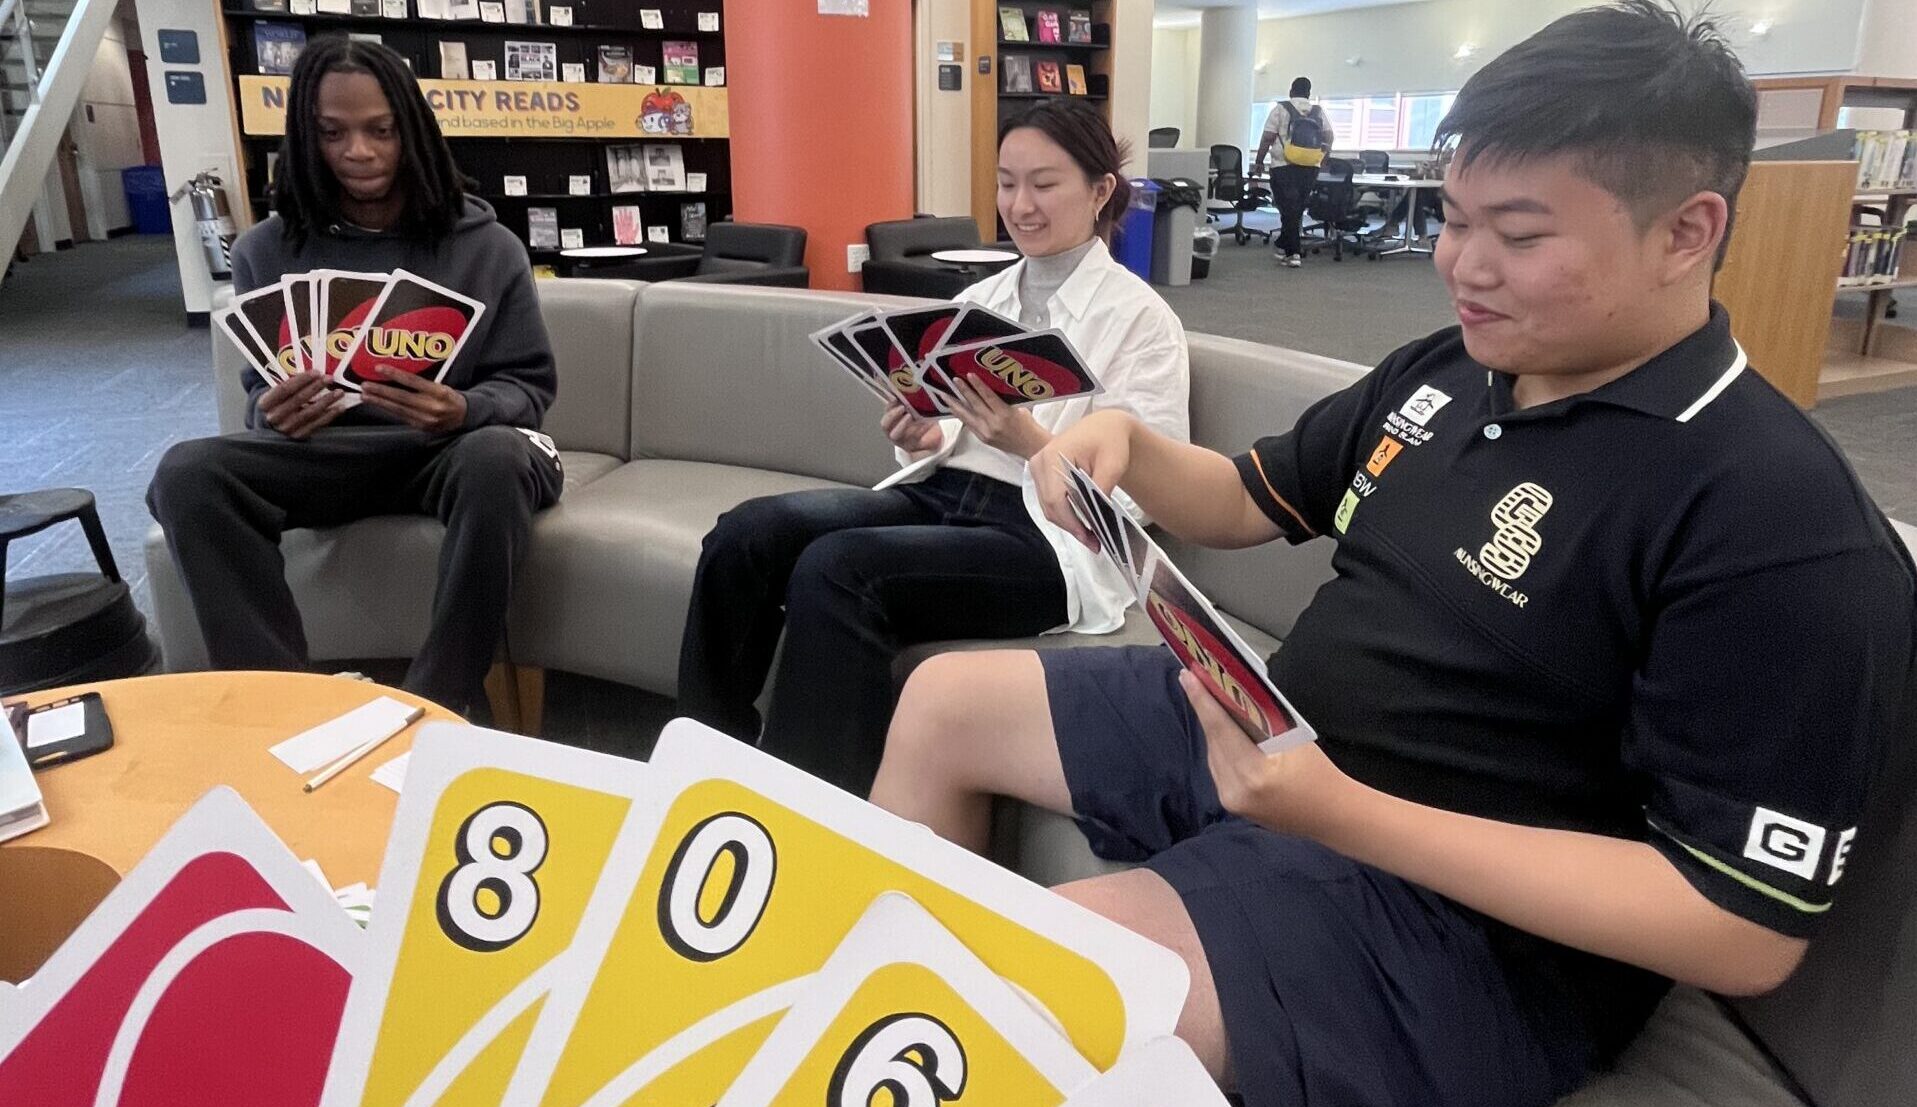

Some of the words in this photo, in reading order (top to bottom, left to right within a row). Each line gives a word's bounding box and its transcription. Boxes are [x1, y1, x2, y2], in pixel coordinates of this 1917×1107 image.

[425, 89, 486, 111] CITY
[494, 90, 581, 113] READS
[462, 116, 508, 129] based
[510, 117, 523, 129] in
[526, 117, 551, 129] the
[552, 117, 574, 133] Big
[576, 117, 616, 131] Apple
[366, 327, 456, 361] UNO
[974, 346, 1056, 401] UNO
[1760, 822, 1811, 862] G
[436, 800, 549, 953] 8
[657, 811, 778, 963] 0
[826, 1012, 968, 1107] 6
